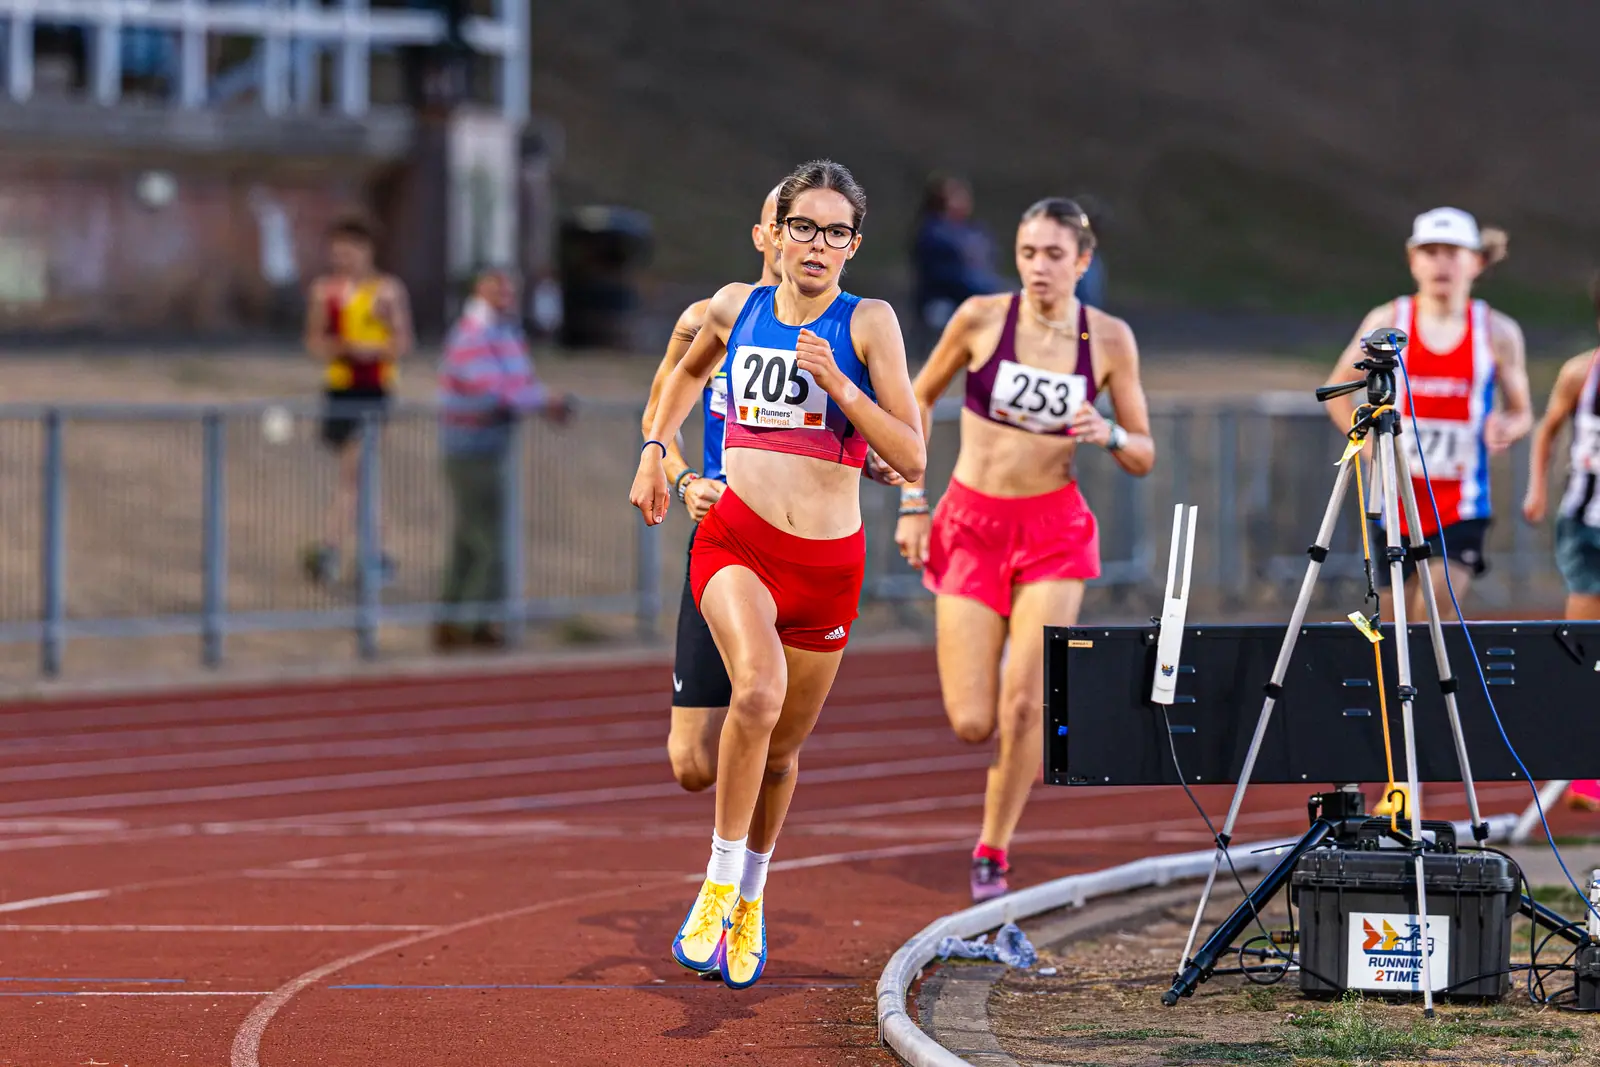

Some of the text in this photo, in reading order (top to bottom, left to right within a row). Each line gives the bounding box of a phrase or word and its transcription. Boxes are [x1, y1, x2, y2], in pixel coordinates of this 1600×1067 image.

[743, 353, 809, 405] 205
[1009, 374, 1069, 417] 253
[761, 408, 793, 417] Runners'
[760, 416, 790, 426] Retreat
[1374, 969, 1421, 983] 2TIME
